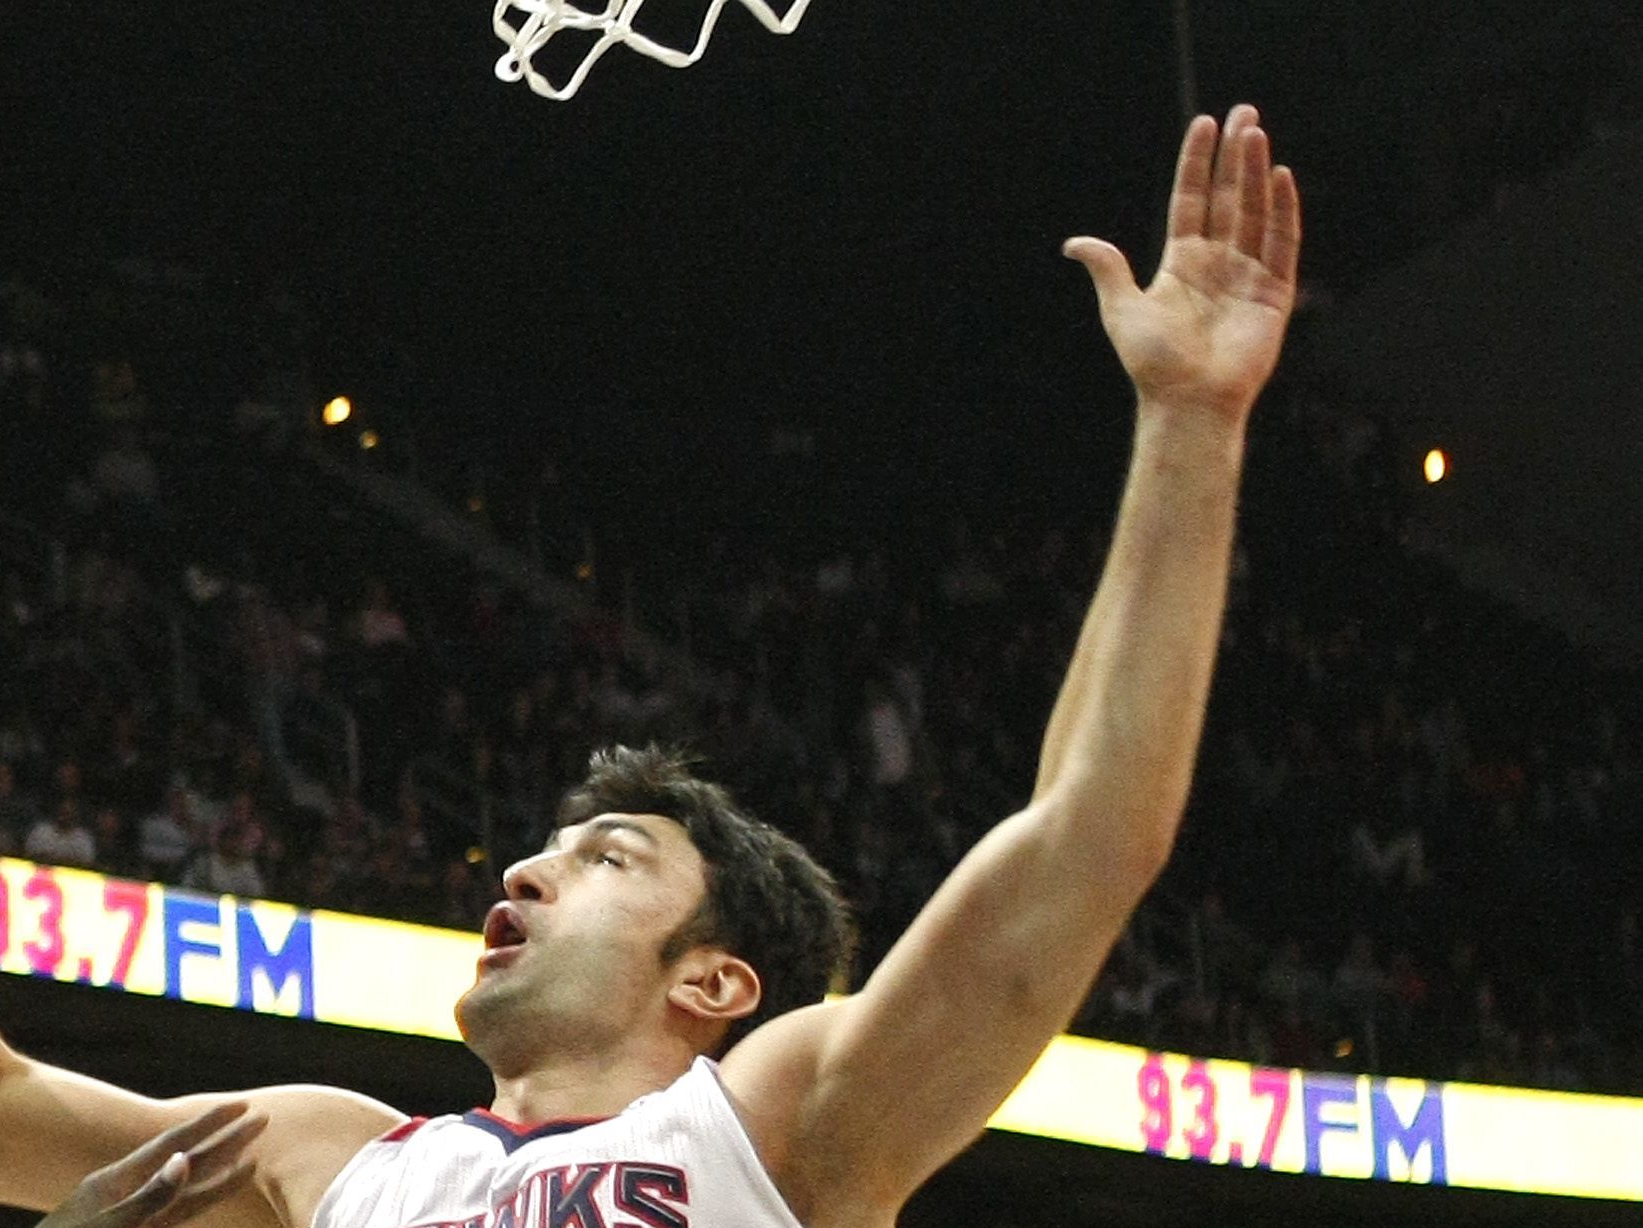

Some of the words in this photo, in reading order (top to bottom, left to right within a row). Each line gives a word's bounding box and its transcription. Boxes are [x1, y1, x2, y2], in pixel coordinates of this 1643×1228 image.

[164, 888, 314, 1021] FM
[1138, 1052, 1290, 1170] 93.7
[1301, 1071, 1448, 1186] FM
